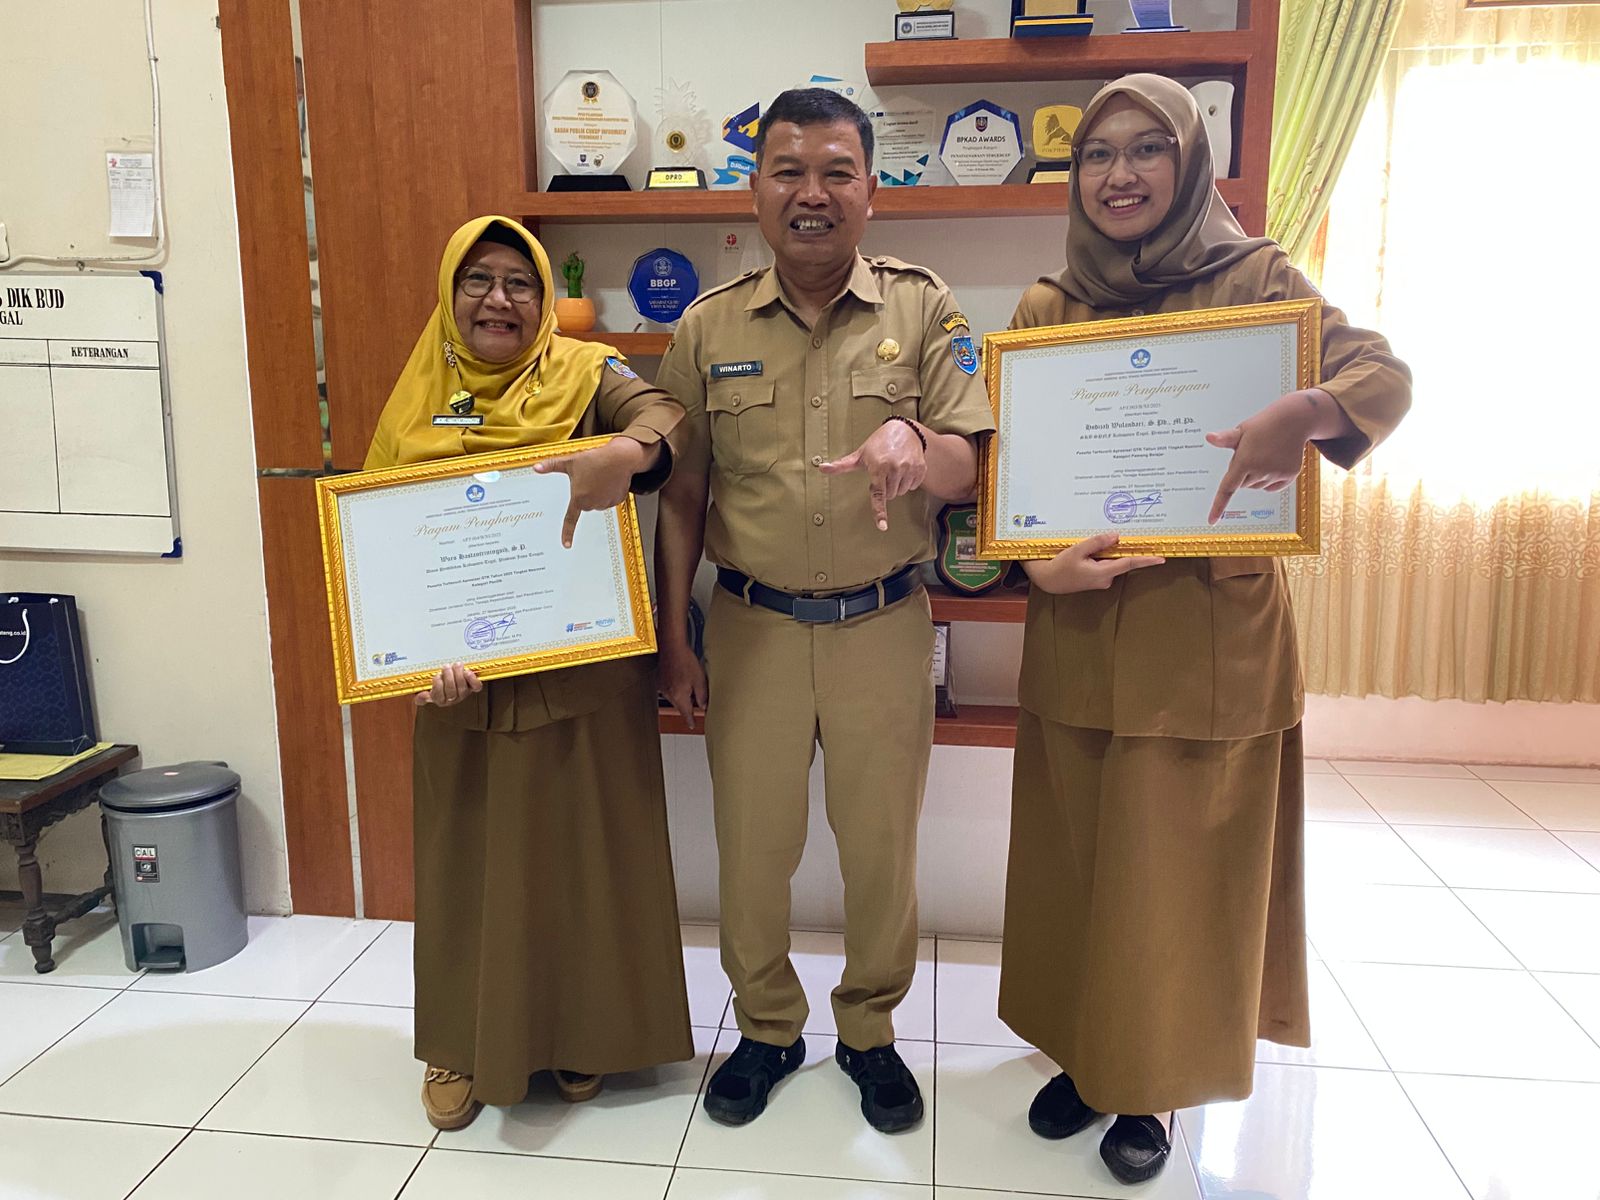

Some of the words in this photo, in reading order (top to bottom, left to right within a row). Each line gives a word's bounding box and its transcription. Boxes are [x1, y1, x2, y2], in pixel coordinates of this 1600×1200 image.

[650, 279, 677, 287] BBGP
[6, 288, 33, 308] DIK
[34, 288, 64, 308] BUD
[71, 347, 129, 358] KETERANGAN
[719, 364, 751, 373] WINARTO
[1070, 388, 1120, 405] Piagam
[1123, 379, 1211, 400] Penghargaan
[413, 522, 460, 540] Piagam
[464, 510, 544, 531] Penghargaan
